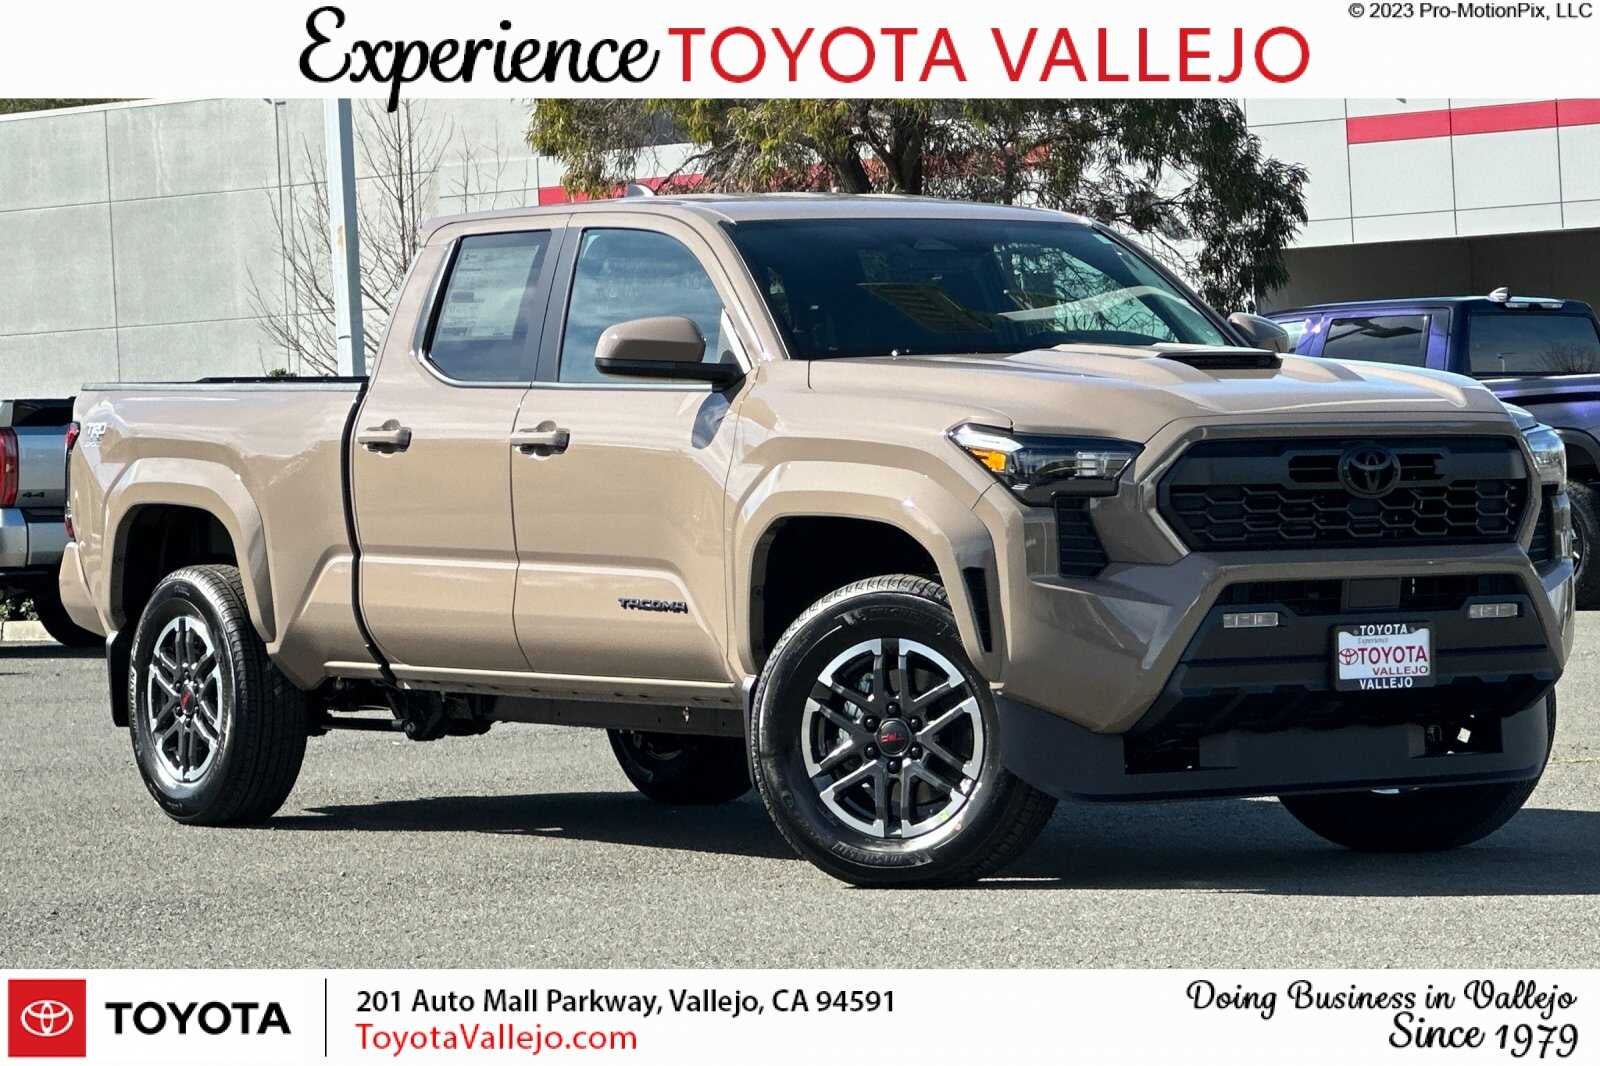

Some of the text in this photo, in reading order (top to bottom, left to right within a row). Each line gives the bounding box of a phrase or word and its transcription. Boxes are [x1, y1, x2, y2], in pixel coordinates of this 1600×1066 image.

[618, 597, 688, 614] TACOMA
[1360, 623, 1408, 636] TOYOTA
[1358, 645, 1428, 664] TOYOTA
[1373, 665, 1428, 675] VALLEJO
[1360, 677, 1413, 690] VALLEJO
